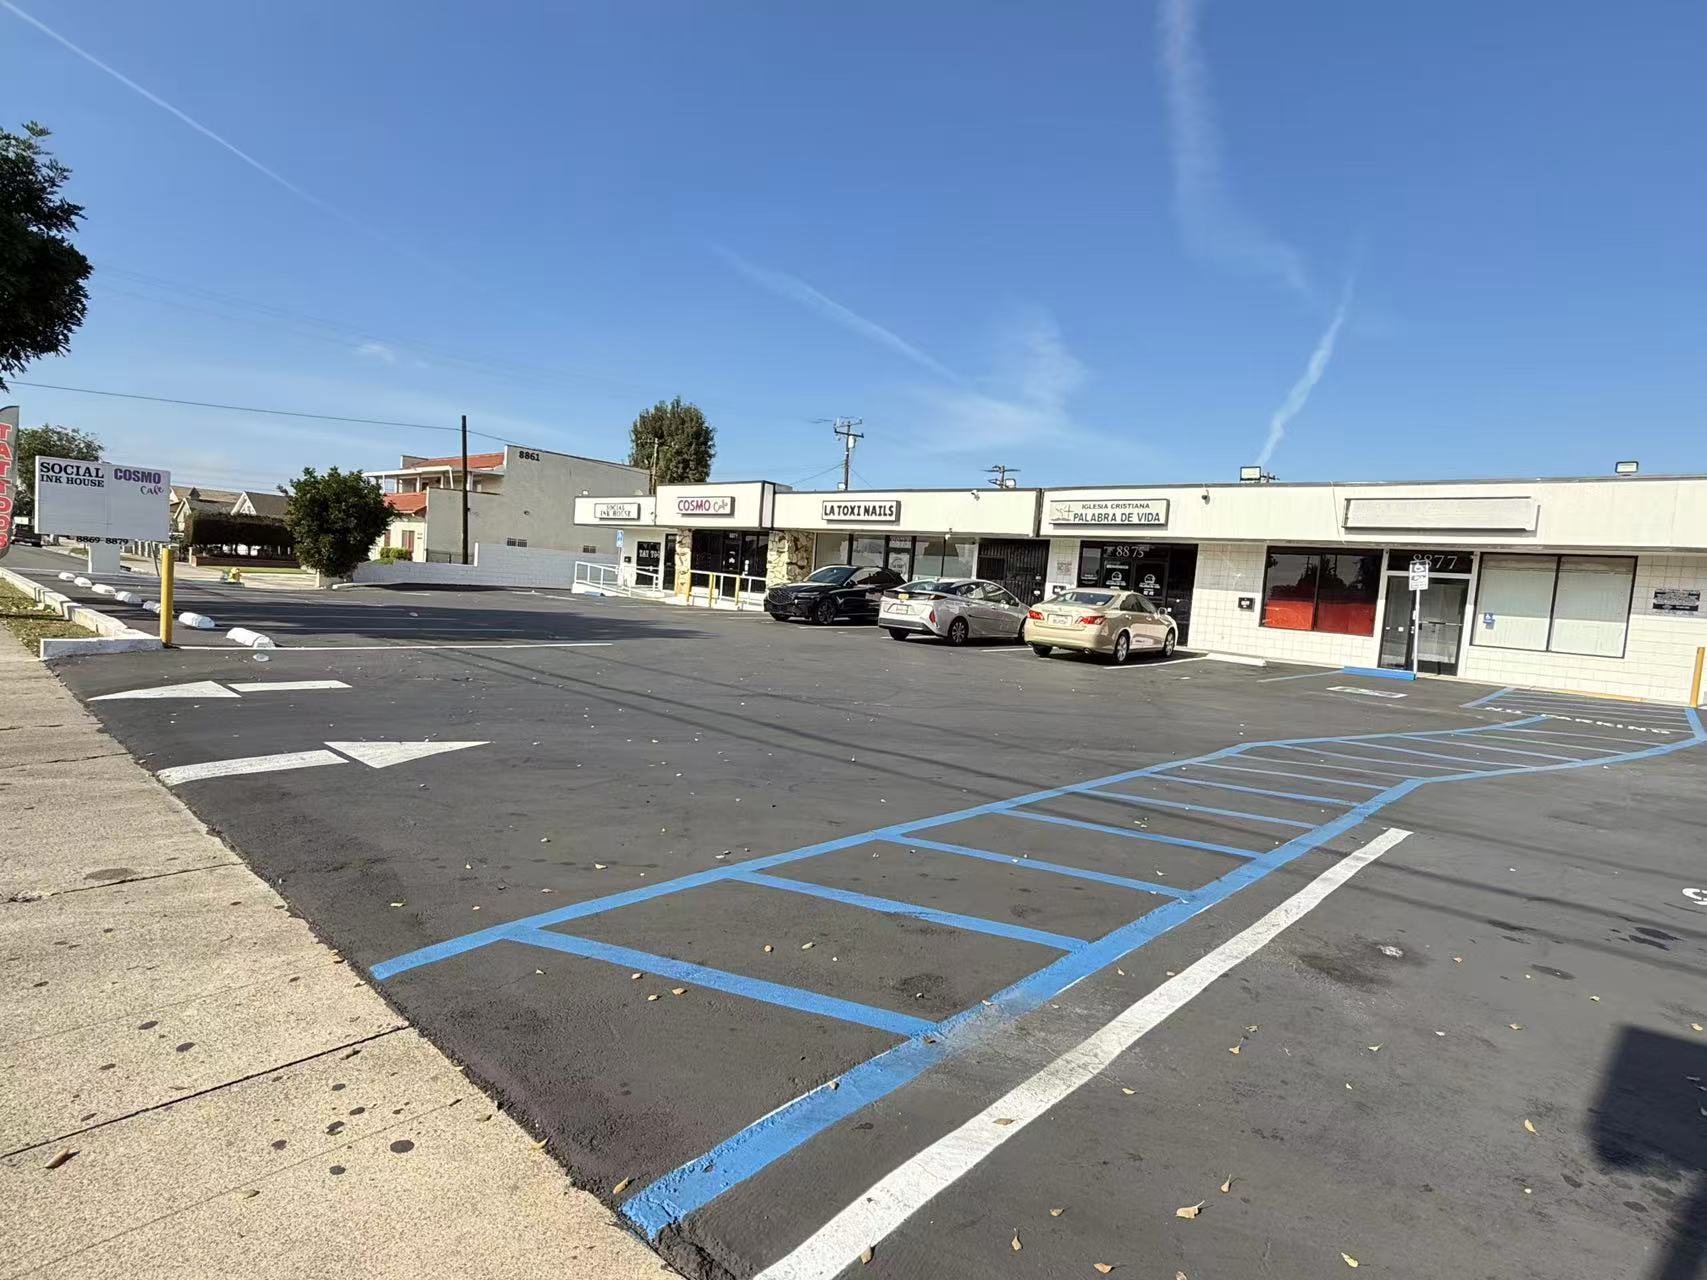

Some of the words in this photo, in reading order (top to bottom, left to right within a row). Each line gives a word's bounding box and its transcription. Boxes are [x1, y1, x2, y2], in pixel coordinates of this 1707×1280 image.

[518, 450, 541, 462] 8861
[39, 461, 105, 479] SOCIAL
[113, 468, 162, 484] COSMO
[39, 474, 64, 484] INK
[65, 476, 105, 488] HOUSE
[677, 499, 711, 512] COSMO
[824, 505, 836, 516] LA
[836, 505, 862, 516] TOXI
[863, 505, 894, 517] NAILS
[1073, 512, 1117, 523] PALABRA
[1120, 512, 1134, 522] DE
[1137, 512, 1161, 523] VIDA
[1116, 545, 1144, 558] 8875
[1485, 706, 1522, 714] NO
[1540, 713, 1670, 733] PARKING
